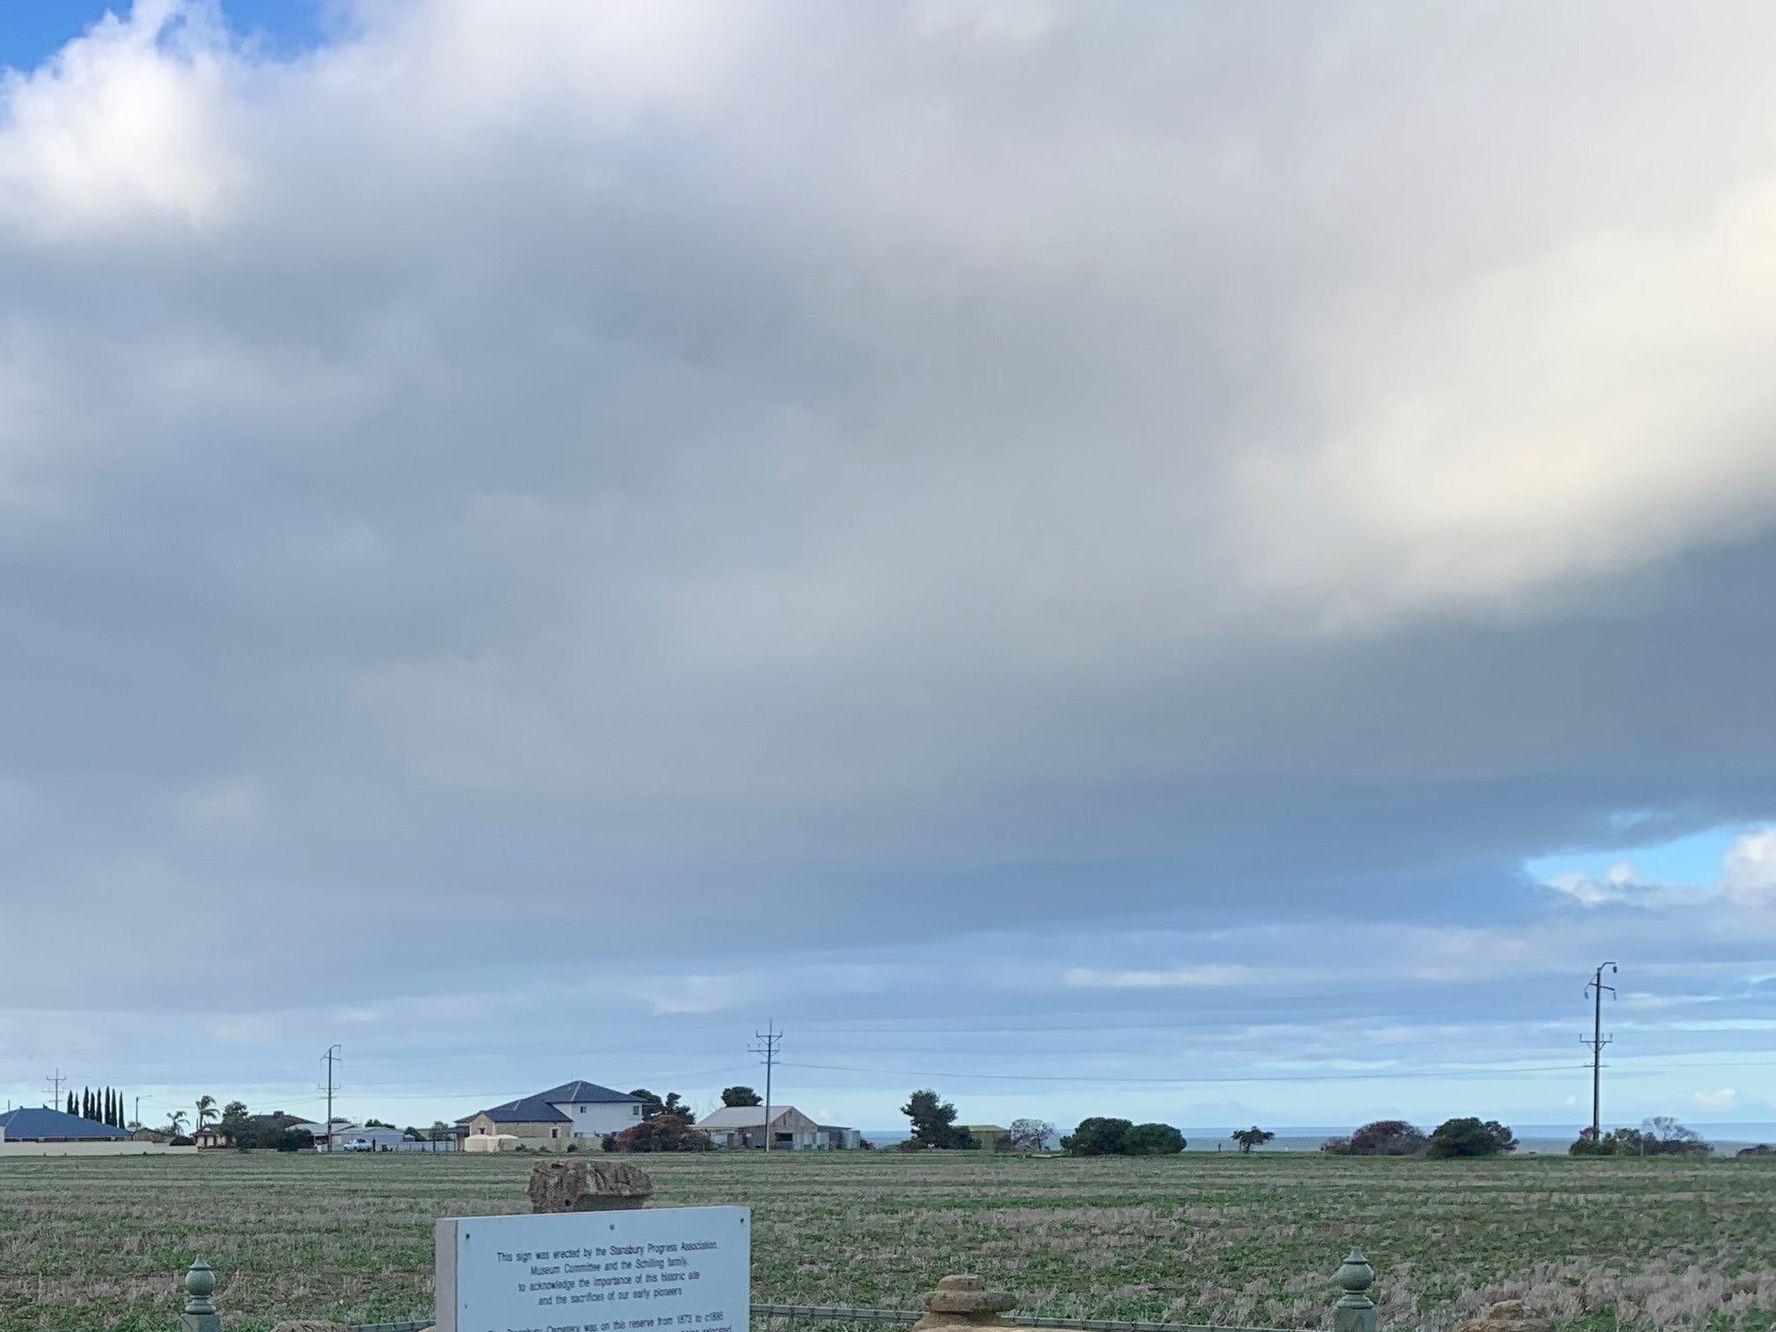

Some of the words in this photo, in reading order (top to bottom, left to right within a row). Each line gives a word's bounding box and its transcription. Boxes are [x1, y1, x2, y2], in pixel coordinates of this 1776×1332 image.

[496, 1251, 513, 1262] This
[516, 1252, 531, 1263] sign
[535, 1251, 549, 1260] was
[553, 1249, 580, 1259] erected
[583, 1248, 592, 1259] by
[595, 1247, 607, 1256] the
[609, 1245, 643, 1256] Stansbury
[647, 1243, 677, 1255] Progress
[530, 1265, 560, 1275] Museum
[604, 1261, 618, 1271] and
[620, 1261, 632, 1269] the
[635, 1258, 664, 1269] Schilling
[518, 1283, 526, 1292] to
[529, 1279, 575, 1291] acknowledge
[578, 1279, 590, 1288] the
[593, 1276, 632, 1288] importance
[634, 1273, 642, 1284] of
[645, 1274, 658, 1283] this
[660, 1272, 685, 1281] historic
[688, 1271, 700, 1280] site
[538, 1296, 552, 1305] and
[555, 1295, 567, 1304] the
[570, 1292, 605, 1303] sacrifices
[607, 1291, 614, 1300] of
[617, 1291, 629, 1299] our
[632, 1288, 650, 1299] early
[584, 1323, 597, 1332] was
[600, 1322, 609, 1331] on
[612, 1320, 625, 1330] this
[629, 1319, 654, 1328] reserve
[657, 1316, 672, 1325] from
